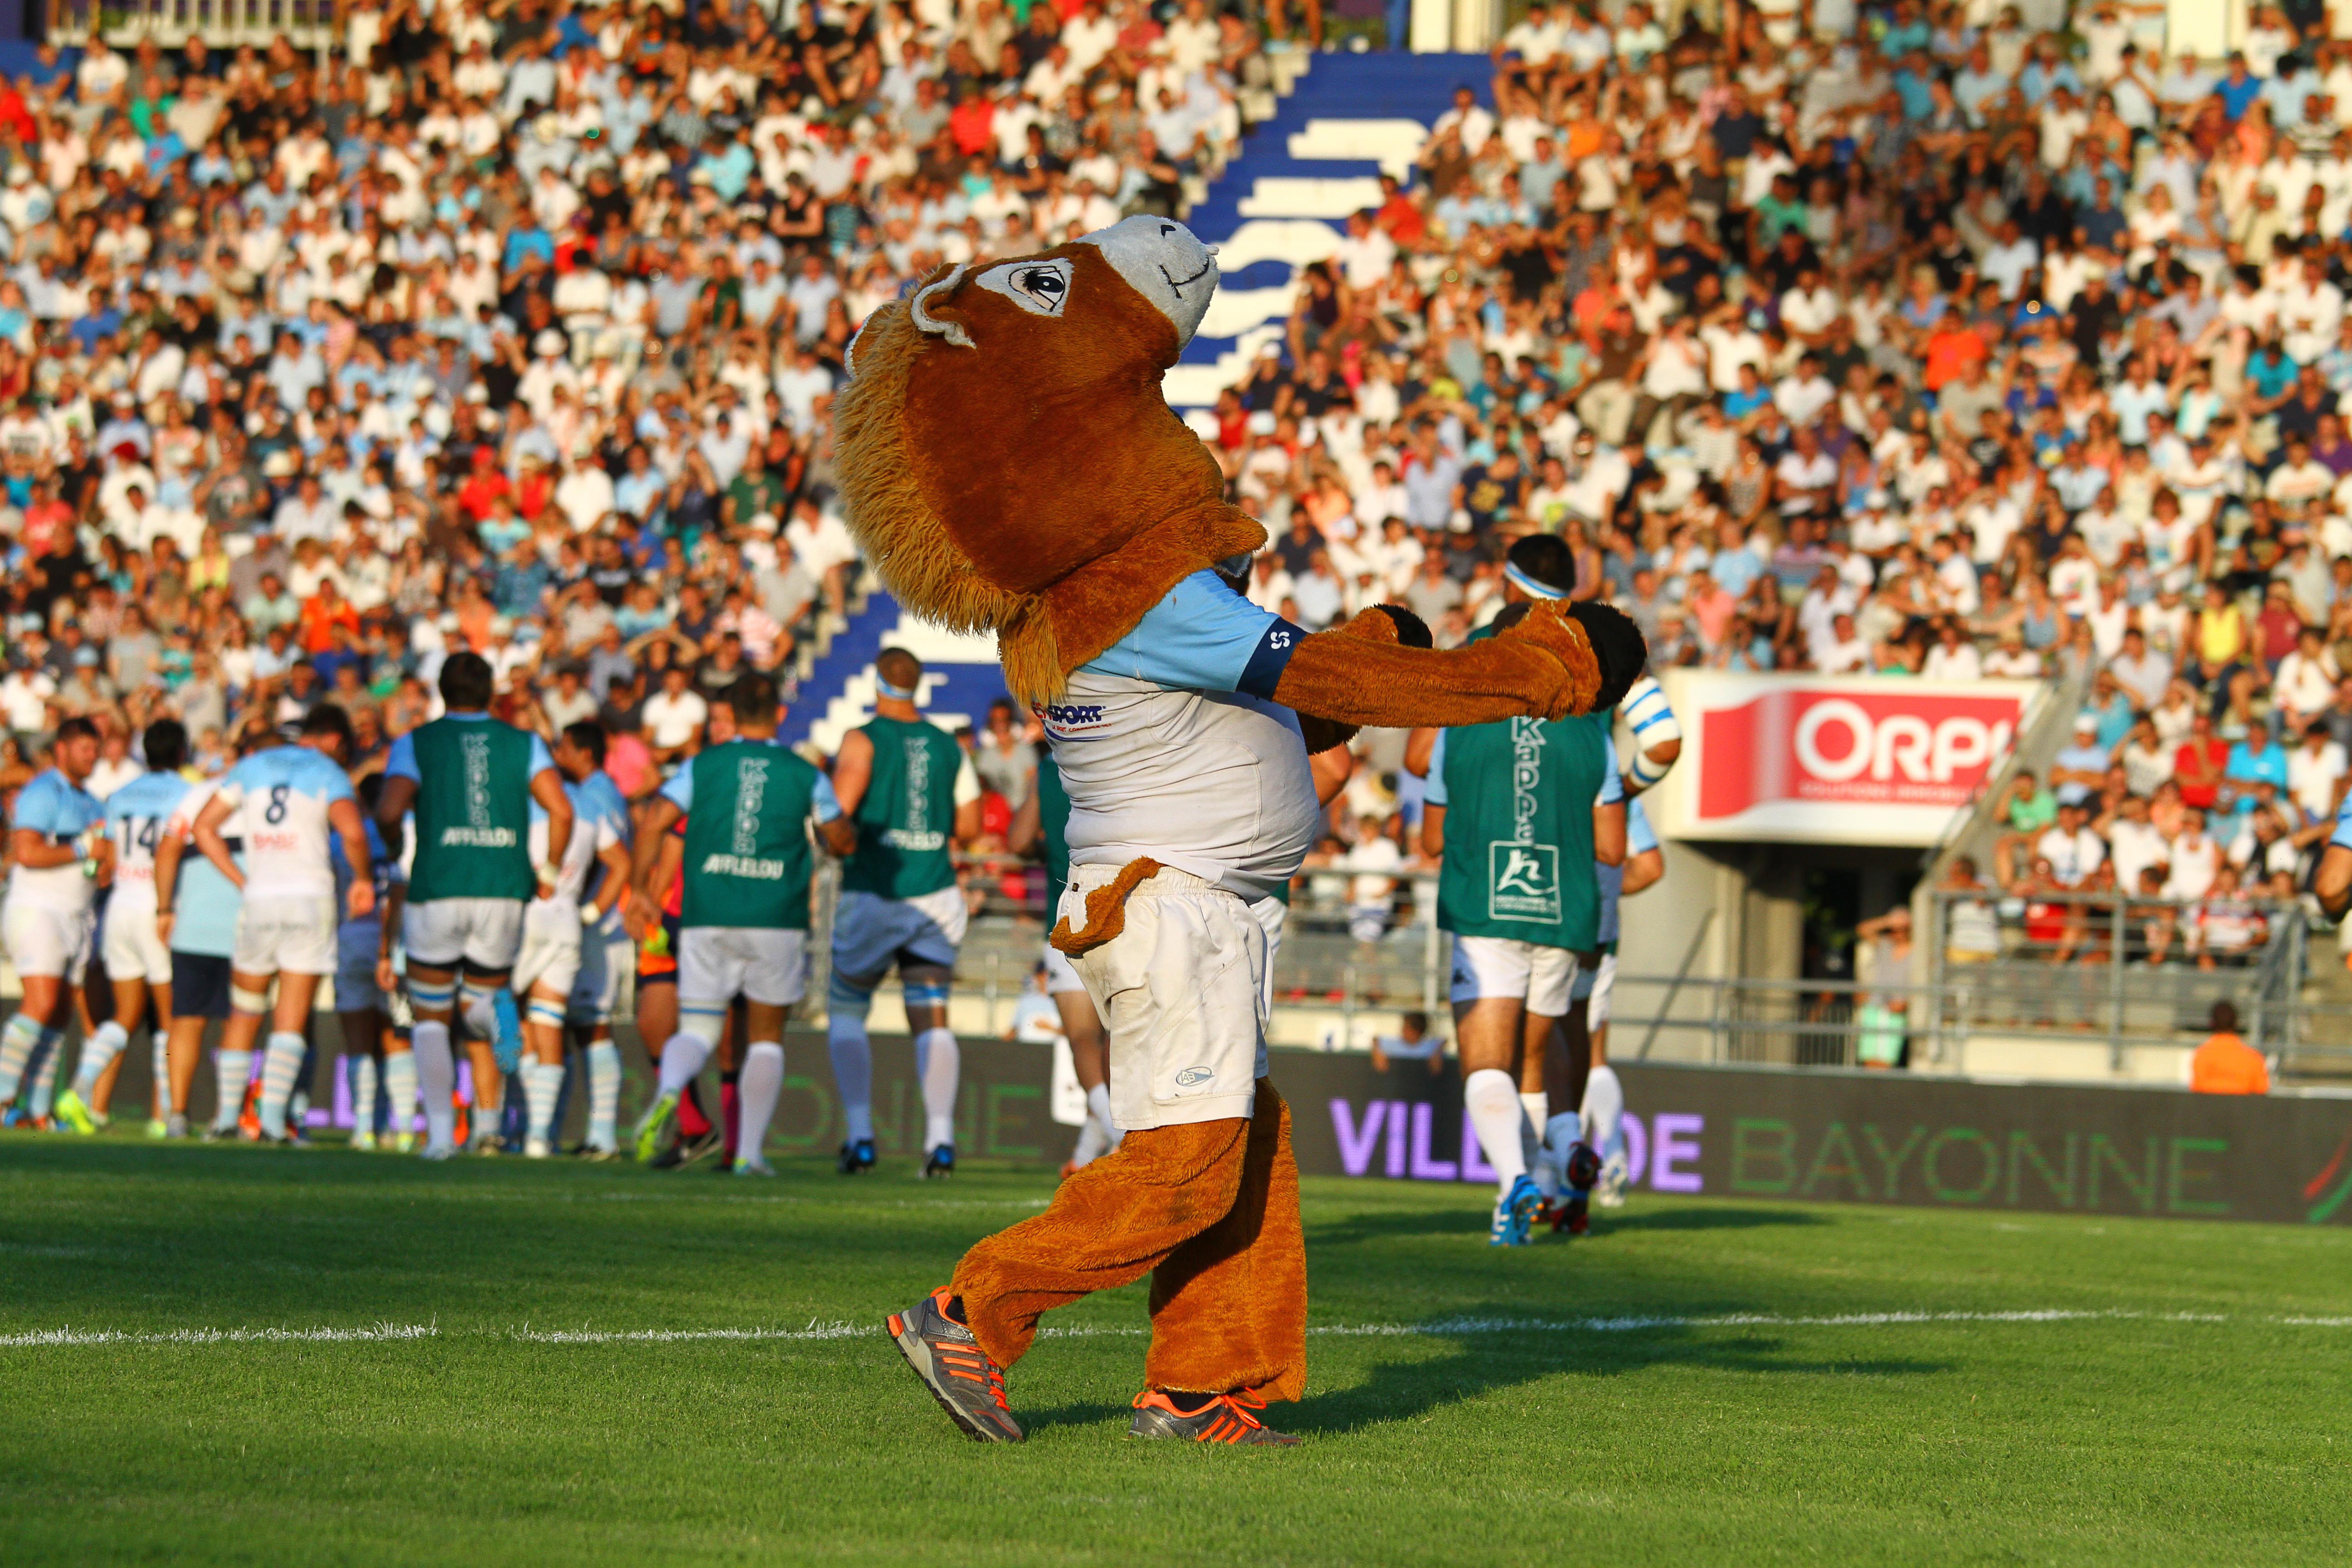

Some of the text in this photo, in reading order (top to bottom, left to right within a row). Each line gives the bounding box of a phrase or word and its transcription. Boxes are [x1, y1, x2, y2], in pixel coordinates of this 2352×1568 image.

[265, 782, 291, 825] 8
[120, 813, 159, 858] 14
[1328, 1096, 1500, 1184] VILL
[1732, 1117, 2233, 1214] BAYONNE
